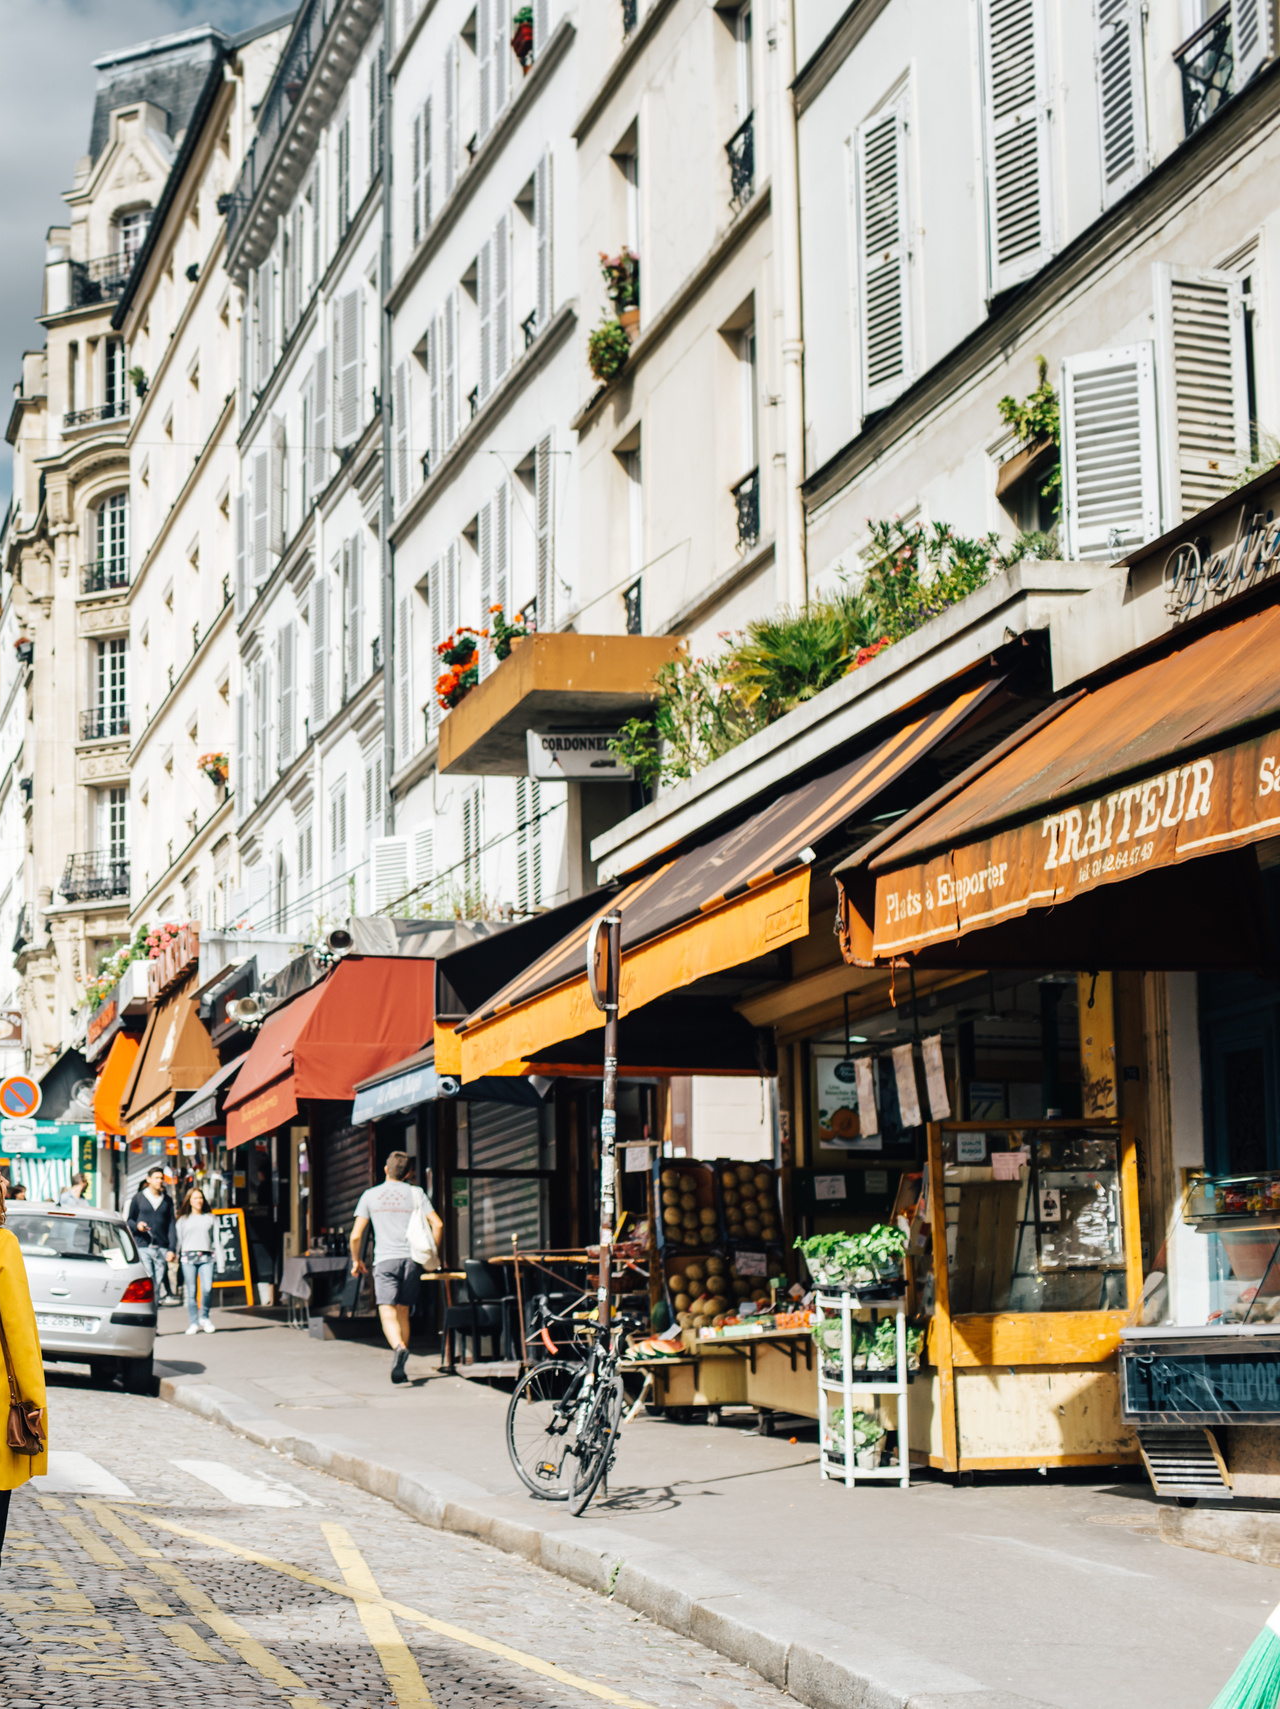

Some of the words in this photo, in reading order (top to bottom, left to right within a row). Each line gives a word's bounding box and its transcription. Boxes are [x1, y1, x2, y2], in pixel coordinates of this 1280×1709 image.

[542, 737, 624, 752] CORDONNE
[1041, 758, 1214, 871] TRAITEUR
[886, 889, 923, 925] Plats
[925, 881, 934, 911] à
[937, 861, 1008, 908] Emporter
[1222, 1362, 1280, 1401] EMPOR
